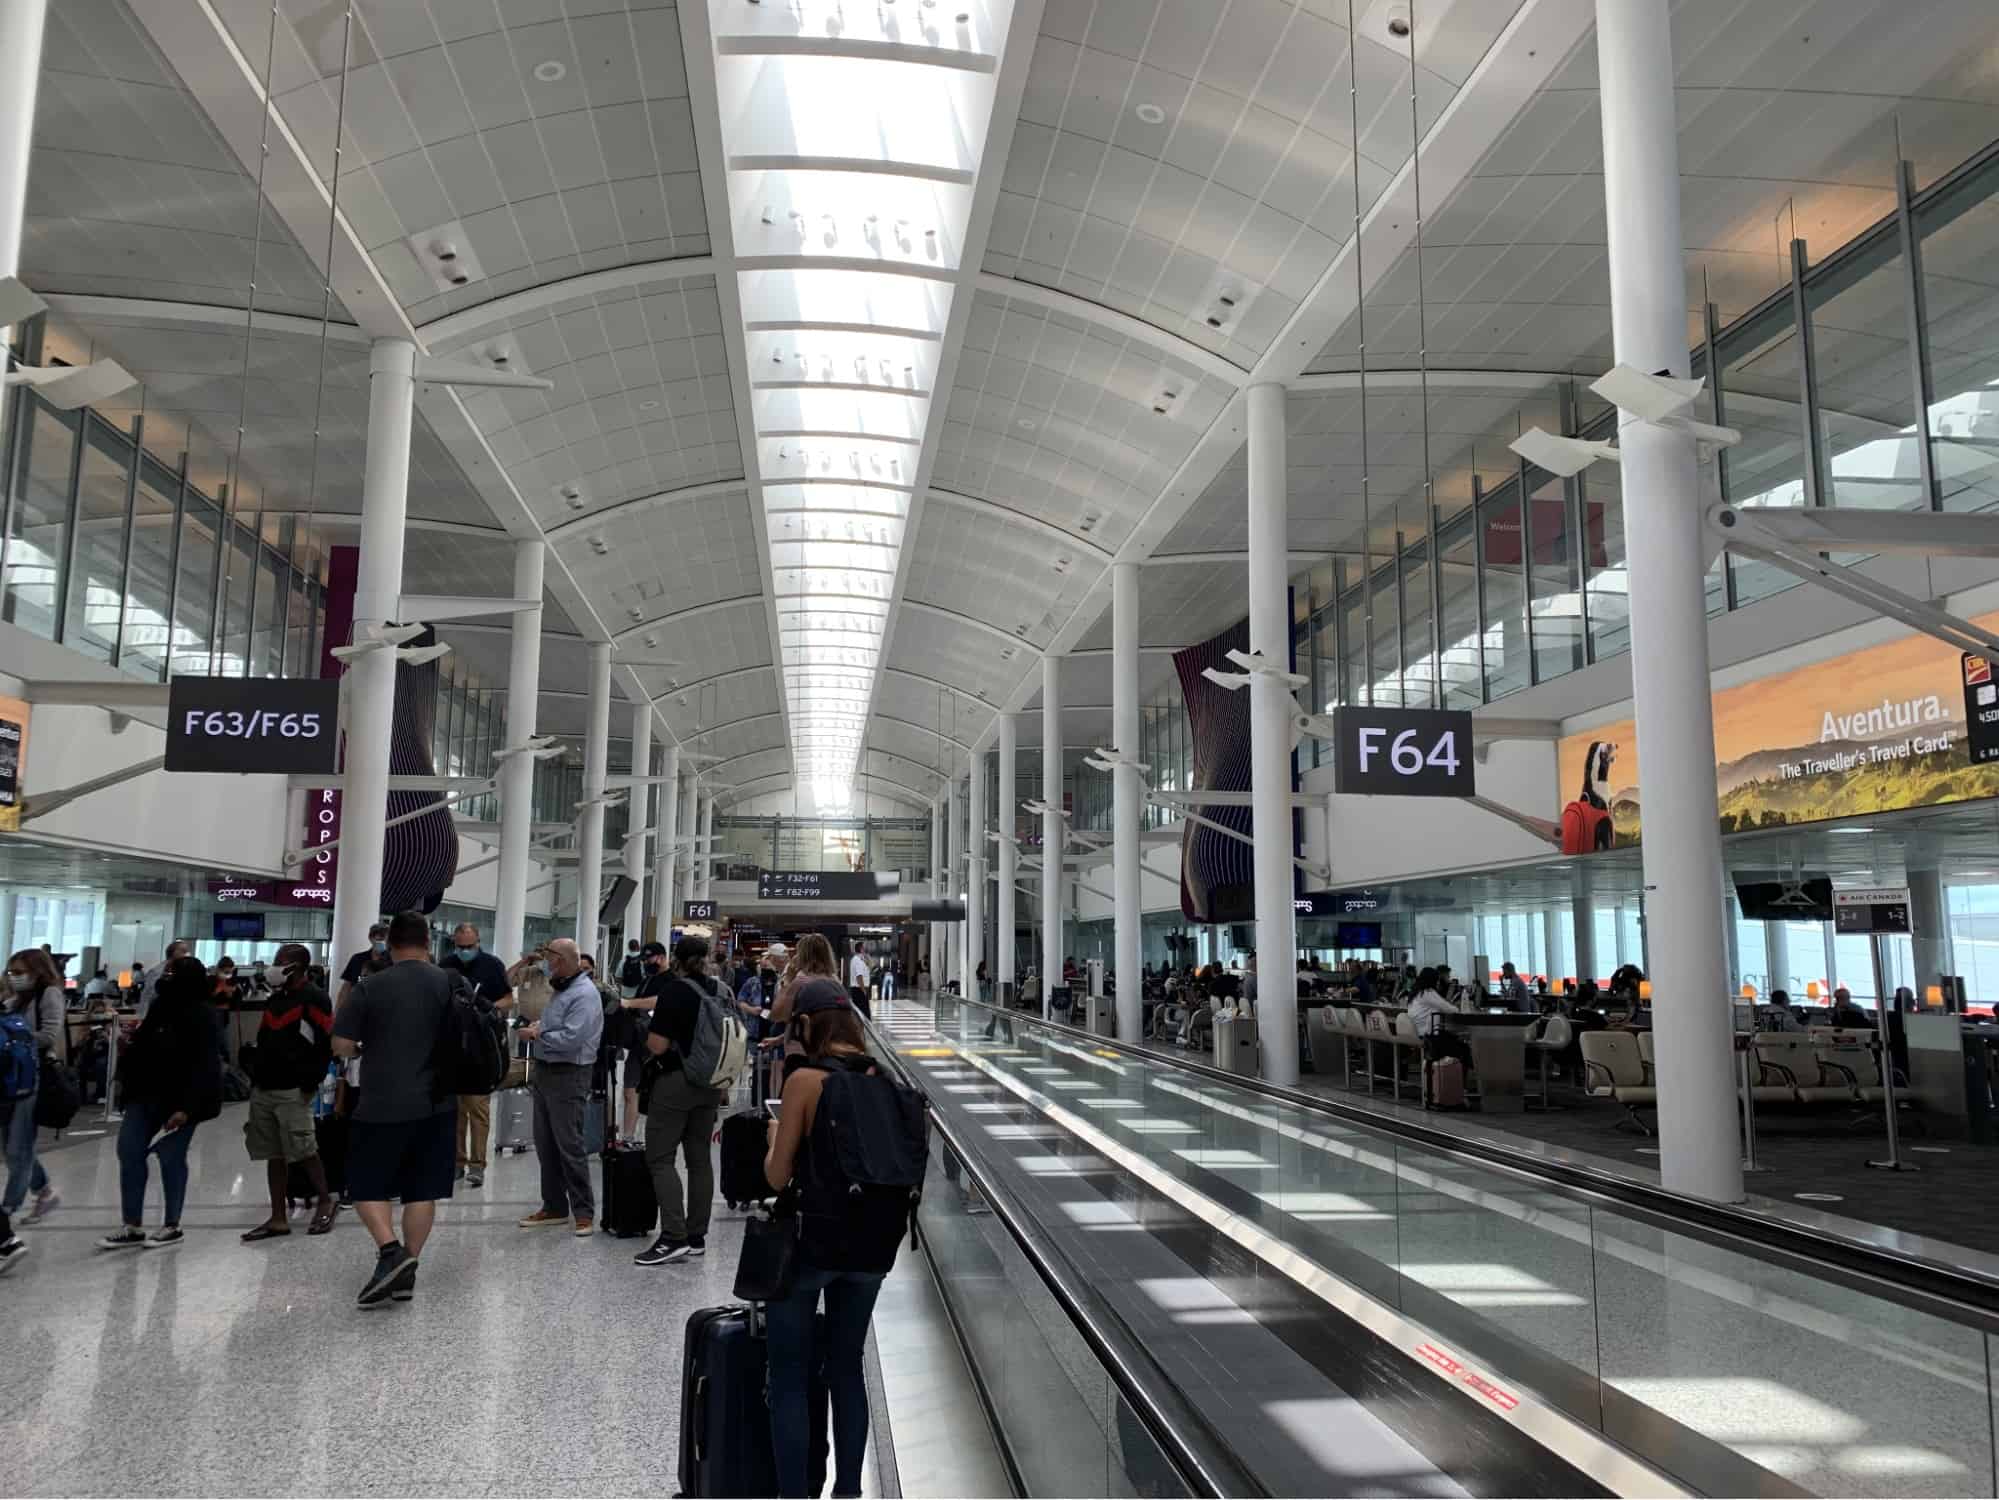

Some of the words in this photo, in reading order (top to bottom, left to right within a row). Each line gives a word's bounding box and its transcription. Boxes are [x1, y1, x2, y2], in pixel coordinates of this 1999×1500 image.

[184, 710, 320, 738] F63/F65
[1820, 695, 1949, 743] Aventura.
[1359, 727, 1460, 776] F64
[1780, 763, 1801, 779] The
[1803, 750, 1866, 775] Traveller's
[1868, 738, 1910, 763] Travel
[316, 789, 334, 884] ROPOS
[292, 888, 331, 902] apropos
[787, 873, 818, 883] F32-F61
[689, 905, 711, 917] F61
